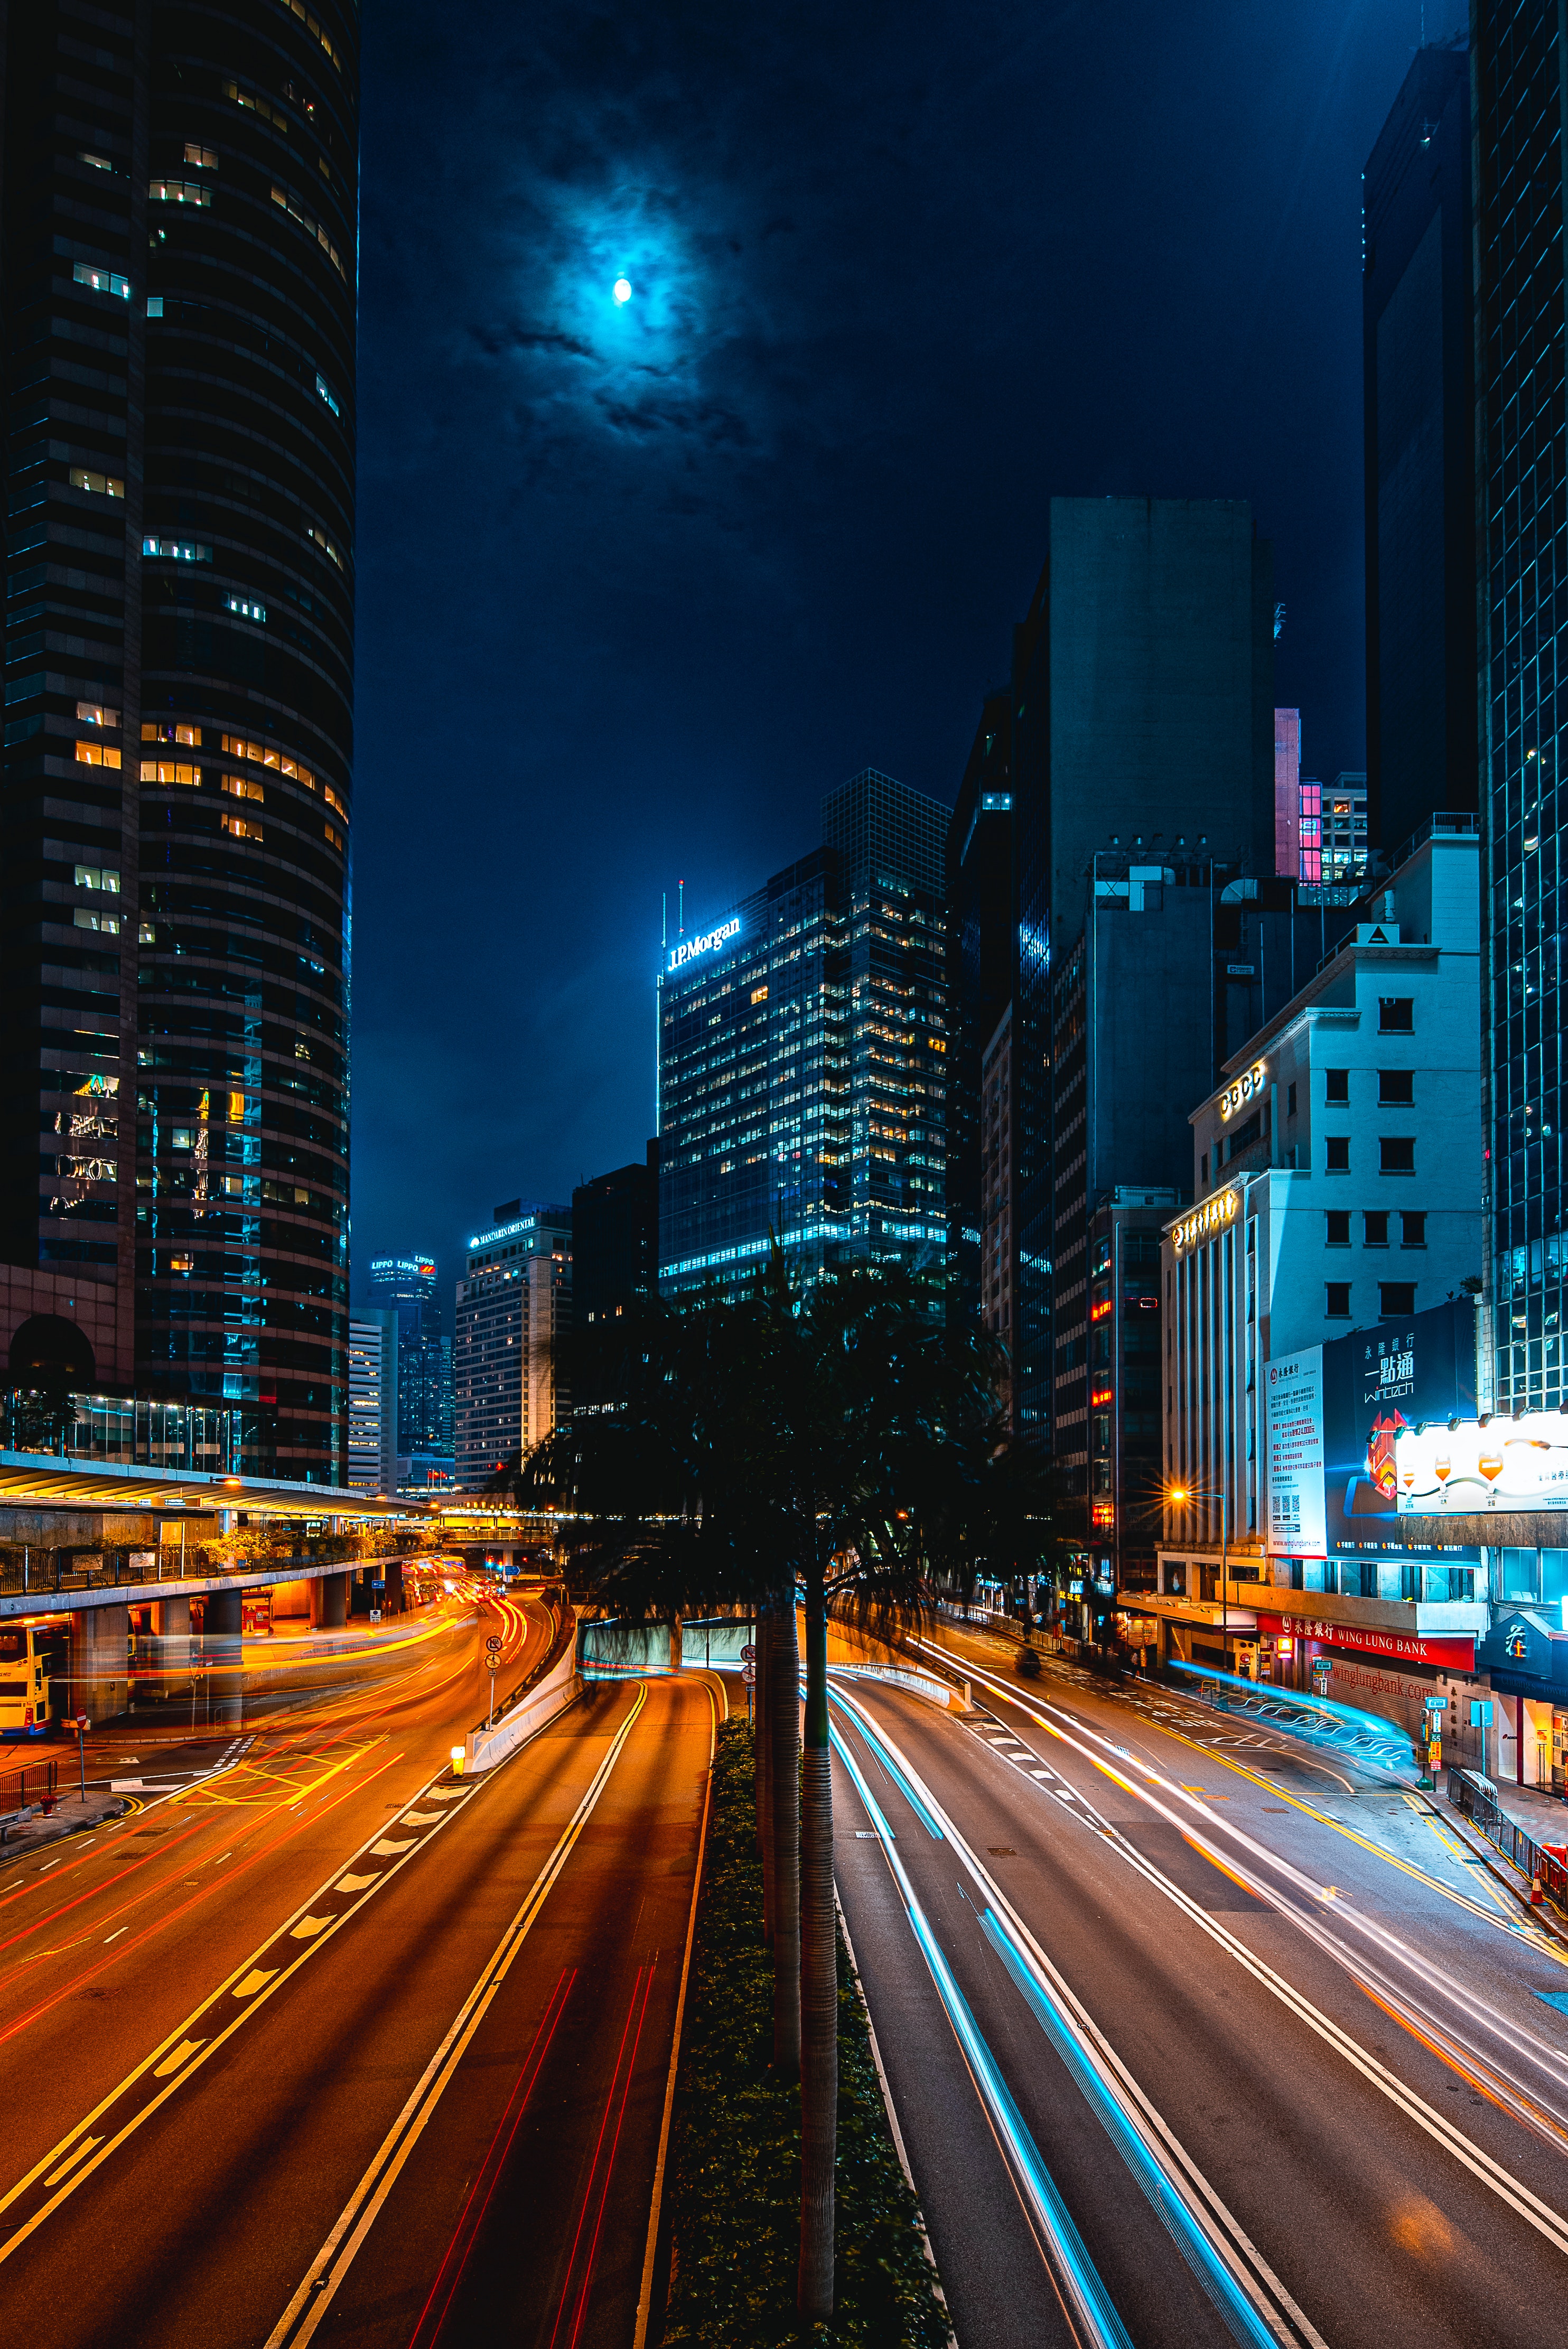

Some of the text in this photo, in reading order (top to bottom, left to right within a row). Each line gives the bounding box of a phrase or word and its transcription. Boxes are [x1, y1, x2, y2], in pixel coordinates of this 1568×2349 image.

[668, 918, 741, 972] J.P.Morgan
[480, 1217, 535, 1245] MANDARIN ORIENTAL
[371, 1260, 393, 1270] LIPPO
[397, 1260, 418, 1272] LIPPO
[415, 1255, 434, 1265] LIPPO
[1365, 1333, 1414, 1359] 永隆銀行
[1365, 1351, 1414, 1385] 一點通
[1272, 1539, 1321, 1548] www.winglungbank.com
[1295, 1619, 1333, 1640] 永隆銀行
[1338, 1630, 1428, 1656] WING LUNG BANK
